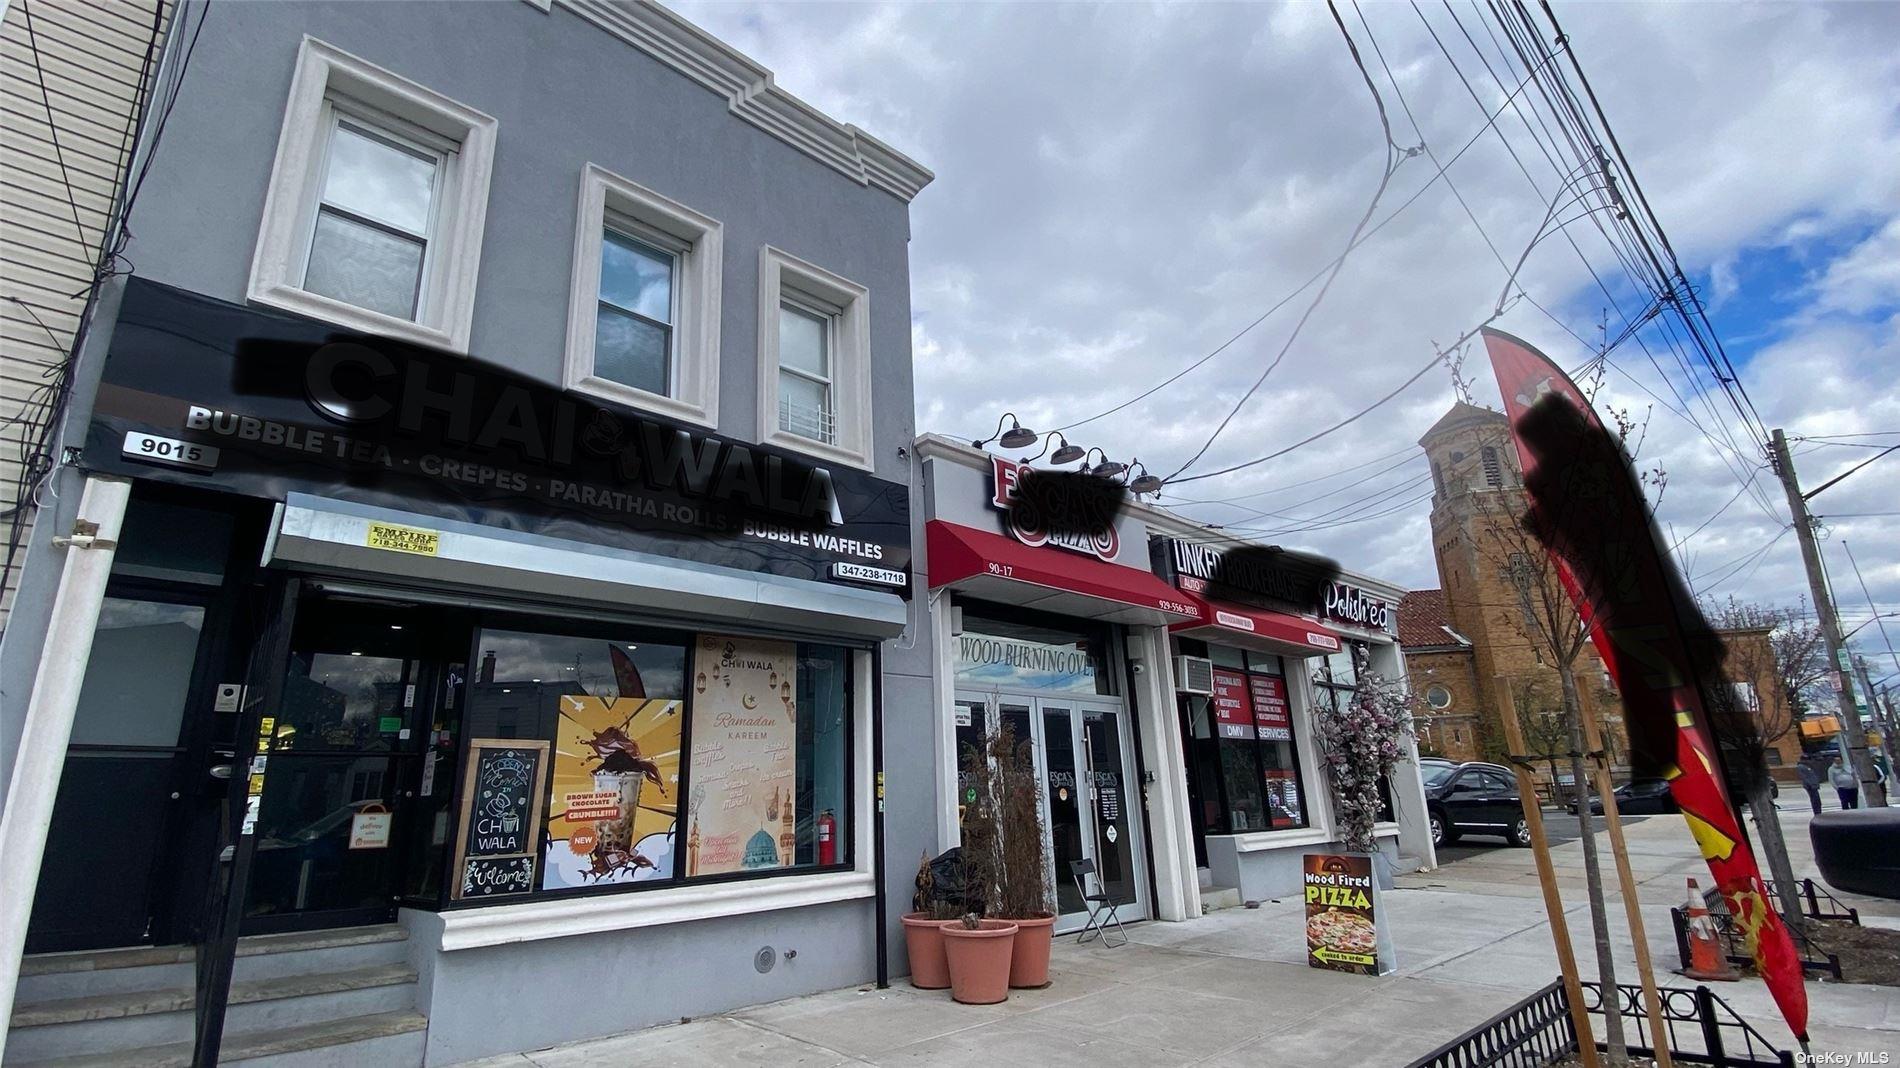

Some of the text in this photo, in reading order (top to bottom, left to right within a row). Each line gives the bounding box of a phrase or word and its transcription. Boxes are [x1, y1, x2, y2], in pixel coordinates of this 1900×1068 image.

[141, 438, 202, 462] 9015
[186, 405, 883, 560] BUBBLE TEA CREPES PARATHA ROLLS BUBBLE WAFFLES
[372, 526, 438, 541] EMPIRE
[1173, 538, 1223, 580] LINKED
[842, 565, 904, 584] 347-238-1718
[988, 562, 1013, 577] 90-17
[1158, 600, 1198, 616] 929-556-3033
[960, 637, 1001, 664] WOOD
[1005, 643, 1064, 673] BURNING
[746, 660, 773, 671] WALA
[713, 711, 776, 728] Ramadan
[728, 732, 768, 740] KAREEM
[1227, 725, 1290, 739] DMV SERVICES
[566, 793, 594, 801] BROWN
[478, 836, 517, 850] WALA
[574, 836, 593, 844] NEW
[1305, 873, 1370, 887] Wood Fired
[1305, 885, 1372, 910] PIZZA
[1321, 952, 1340, 960] cooked
